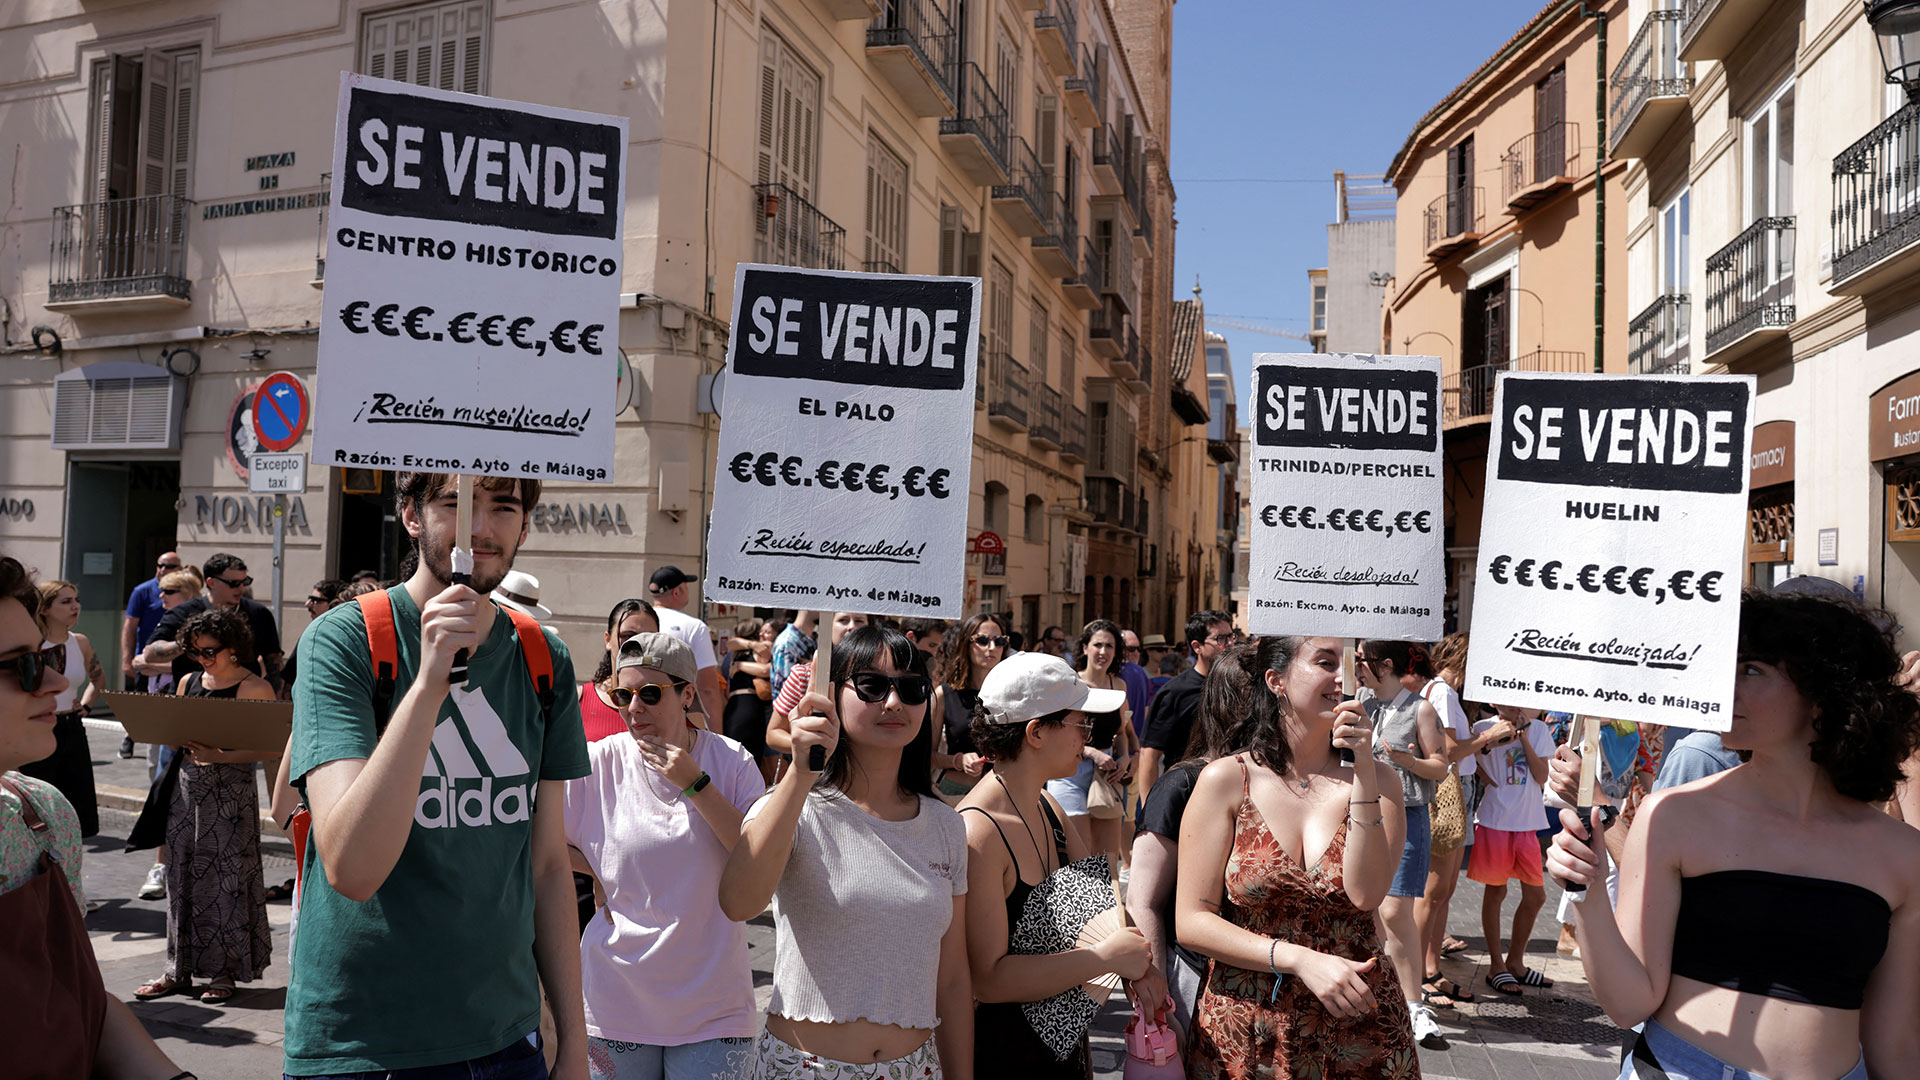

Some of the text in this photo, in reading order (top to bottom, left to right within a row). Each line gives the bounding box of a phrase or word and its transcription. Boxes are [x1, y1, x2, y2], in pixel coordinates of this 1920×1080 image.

[244, 152, 296, 173] PLAZA
[357, 119, 606, 214] SE VENDE
[259, 174, 279, 191] DE
[337, 228, 616, 276] CENTRO HISTORICO
[340, 301, 604, 356] €€€.€€€,€€
[749, 297, 958, 368] SE VENDE
[353, 393, 444, 423] ¡Recién
[799, 397, 894, 421] EL PALO
[1266, 385, 1427, 435] SE VENDE
[1512, 405, 1732, 467] SE VENDE
[255, 458, 299, 473] Excepto
[335, 450, 606, 480] Razón: Excmo. Ayto de Málaga
[1259, 459, 1435, 477] TRINIDAD/PERCHEL
[1751, 446, 1786, 470] armacy
[268, 475, 288, 488] taxi
[728, 452, 950, 500] €€€.€€€,€€
[533, 503, 628, 526] ESANAL
[1260, 505, 1430, 538] €€€.€€€,€€
[1566, 501, 1659, 521] HUELIN
[740, 529, 926, 560] ¡Recién especulado!
[1274, 562, 1419, 587] ¡Recién desalojada!
[1489, 555, 1723, 604] €€€.€€€,€€
[719, 576, 940, 607] Razón: Excmo. Ayto. de Málaga
[1256, 599, 1431, 617] Razón: Excmo. Ayto. de Málaga
[1505, 629, 1701, 666] ¡Recién colonizado!
[1482, 675, 1720, 714] Razón: Excmo. Ayto. de Málaga
